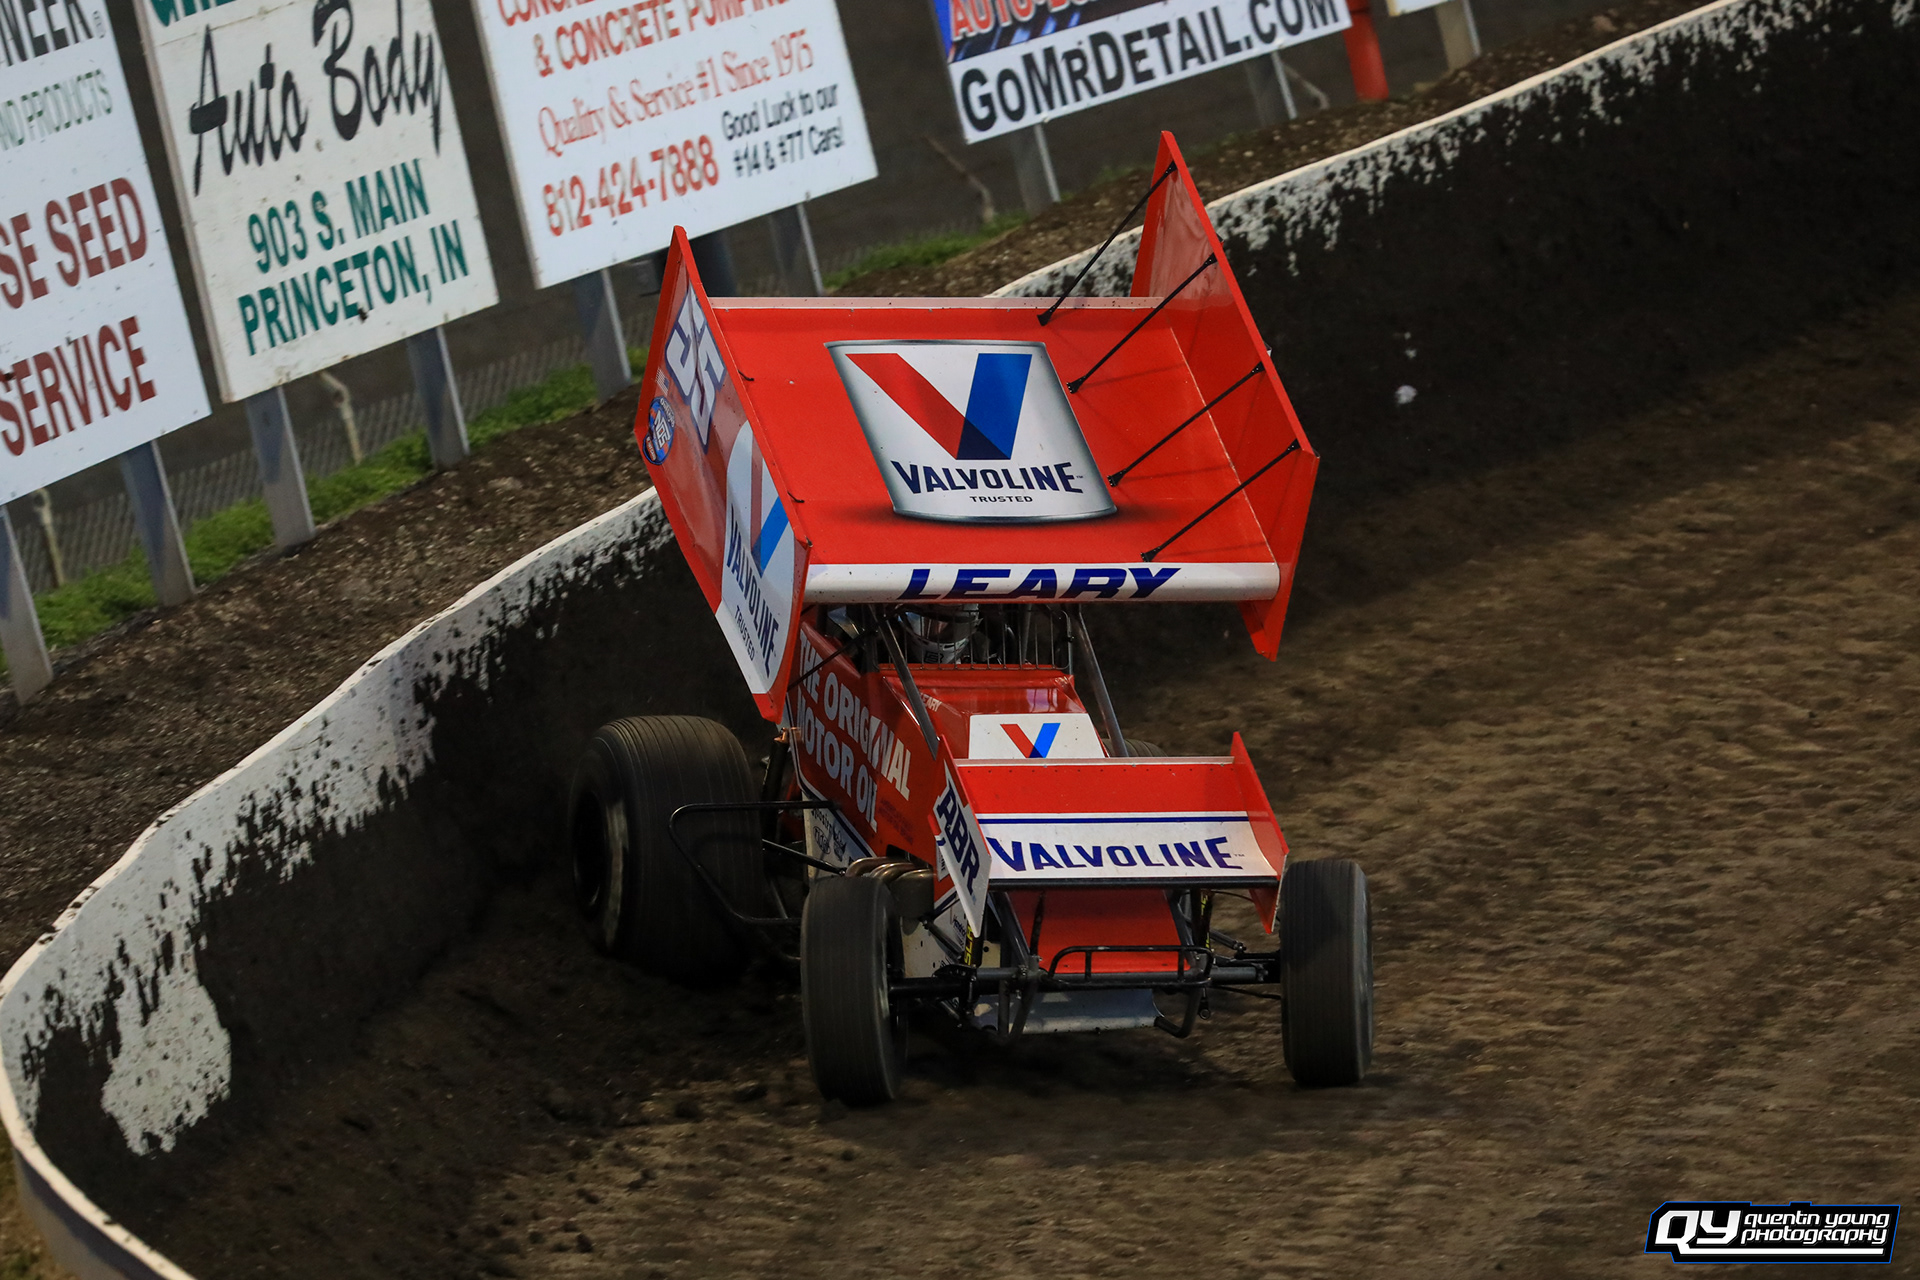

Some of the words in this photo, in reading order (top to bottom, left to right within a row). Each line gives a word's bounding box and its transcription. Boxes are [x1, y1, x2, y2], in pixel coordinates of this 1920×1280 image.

[533, 32, 555, 78] &
[555, 0, 682, 70] CONCRETE
[21, 68, 114, 141] PRODUCTS
[190, 24, 308, 197] Auto
[313, 0, 444, 157] Body
[537, 97, 608, 158] Quality
[607, 85, 633, 129] &
[629, 78, 697, 122] Service
[721, 50, 773, 93] Since
[771, 28, 814, 79] 1975
[721, 101, 760, 142] Good
[761, 90, 799, 129] Luck
[799, 88, 815, 118] to
[816, 83, 839, 111] our
[247, 199, 308, 274] 903
[311, 190, 347, 251] S.
[345, 158, 430, 239] MAIN
[542, 134, 720, 237] 812-424-7888
[45, 177, 148, 288] SEED
[237, 236, 434, 357] PRINCETON,
[429, 219, 470, 285] IN
[0, 315, 158, 457] SERVICE
[891, 460, 1084, 495] VALVOLINE
[969, 495, 1034, 504] TRUSTED
[726, 503, 780, 678] VALVOLINE
[898, 567, 1182, 600] LEARY
[734, 604, 756, 662] TRUSTED
[823, 671, 912, 802] ORIGINAL
[856, 763, 878, 834] OIL
[985, 836, 1244, 873] VALVOLINE
